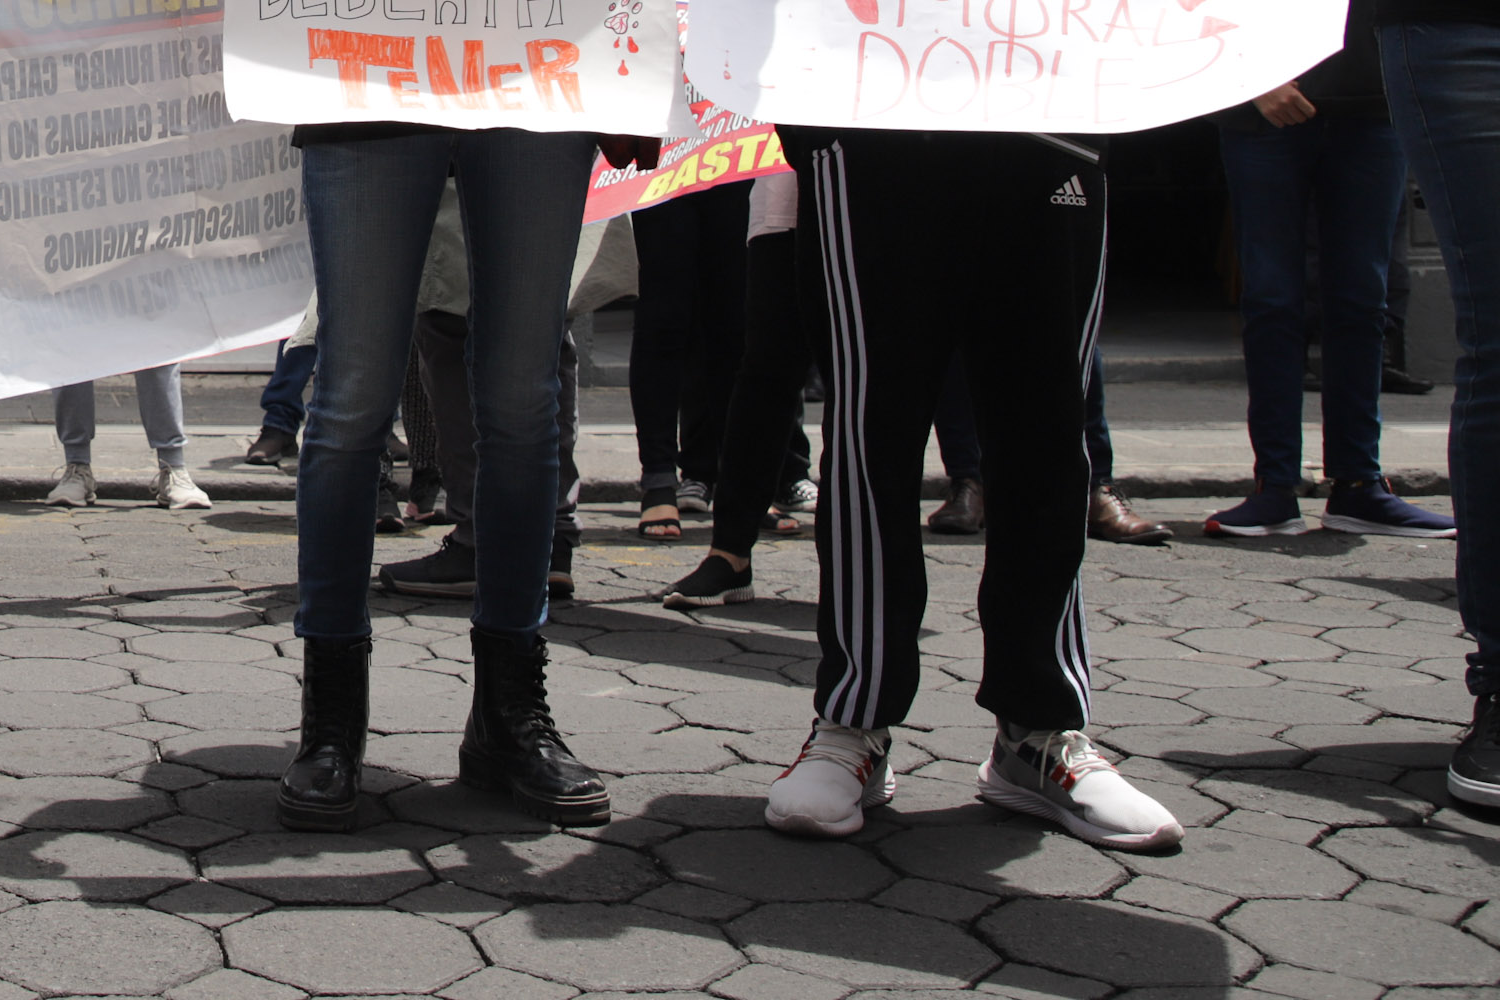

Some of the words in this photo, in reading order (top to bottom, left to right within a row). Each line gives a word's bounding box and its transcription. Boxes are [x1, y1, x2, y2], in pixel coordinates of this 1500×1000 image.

[307, 27, 584, 112] TENER
[852, 31, 1134, 124] DOBLE
[637, 131, 788, 204] BASTA
[1050, 194, 1087, 206] adidas
